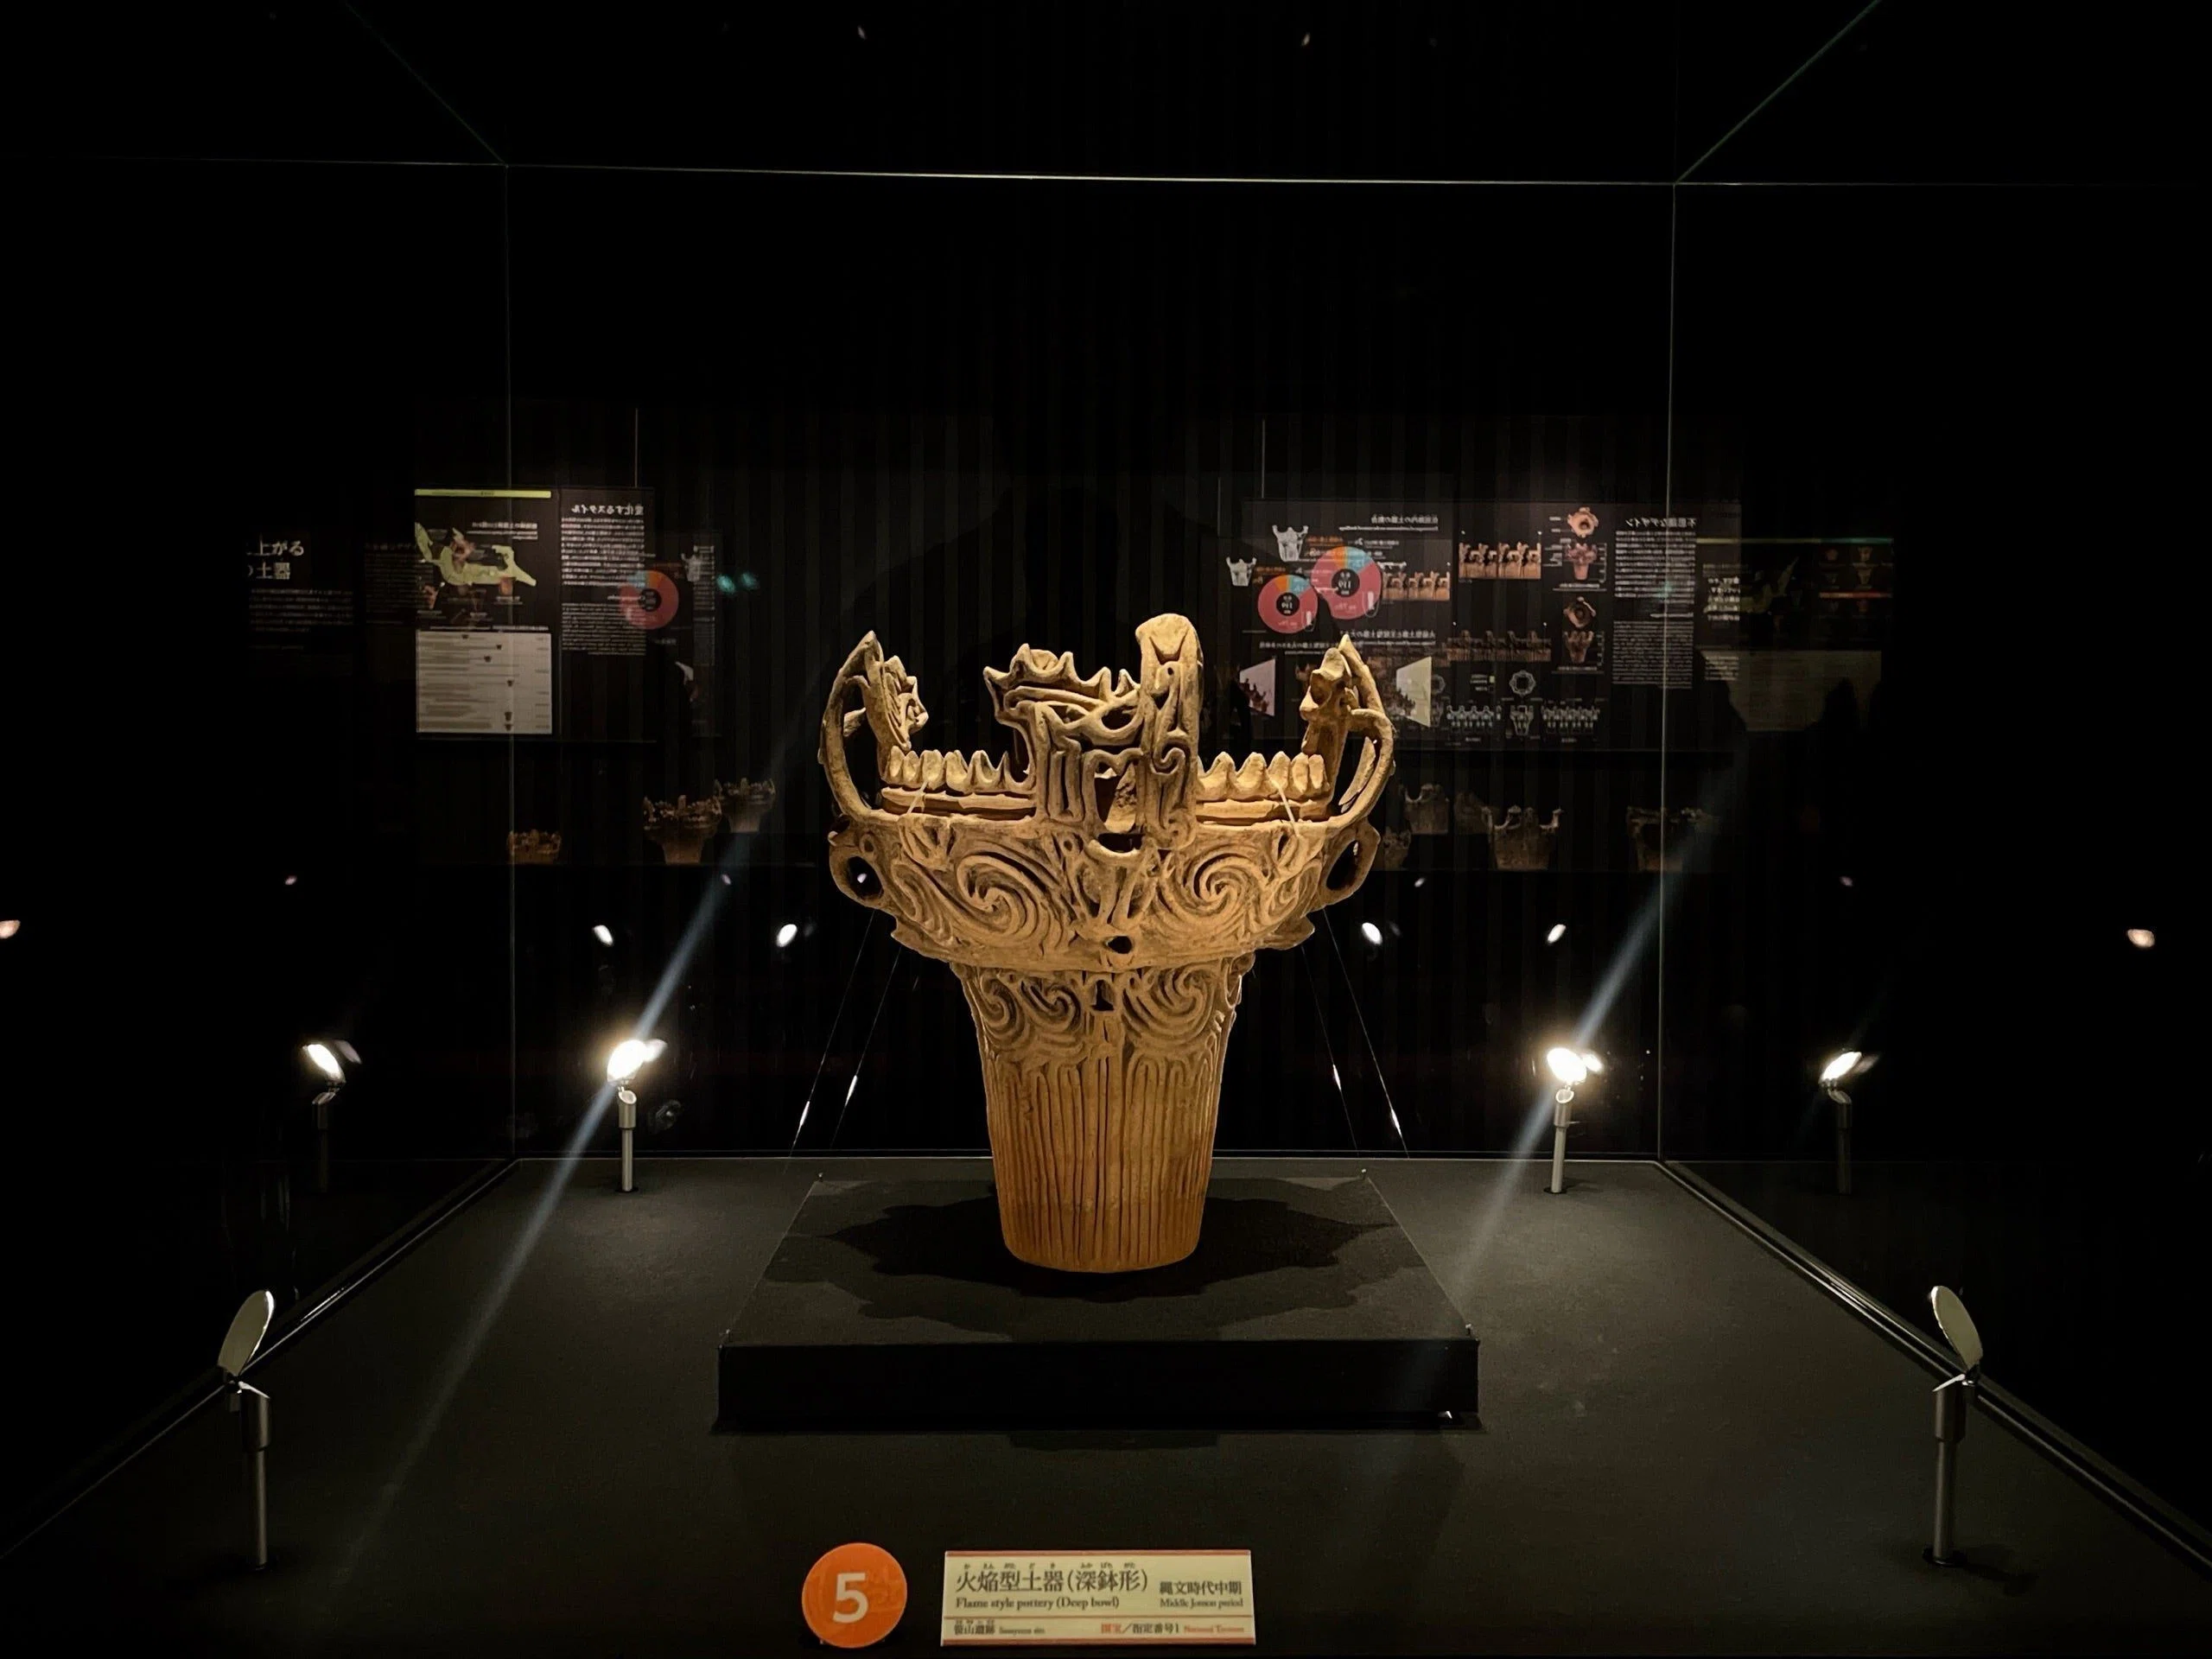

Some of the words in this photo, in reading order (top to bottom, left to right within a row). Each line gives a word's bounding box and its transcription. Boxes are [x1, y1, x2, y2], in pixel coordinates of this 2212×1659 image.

[246, 536, 304, 556] 上がる
[956, 1569, 1147, 1592] 火焔型土器(深鉢形)
[1160, 1580, 1242, 1596] 縄文時代中期
[832, 1573, 868, 1624] 5
[956, 1597, 988, 1608] Flame
[991, 1597, 1014, 1611] style
[1017, 1598, 1053, 1611] pottery
[1056, 1597, 1089, 1611] (Deep
[1090, 1597, 1120, 1609] bowl)
[1160, 1598, 1189, 1607] Middle
[1217, 1598, 1244, 1609] period
